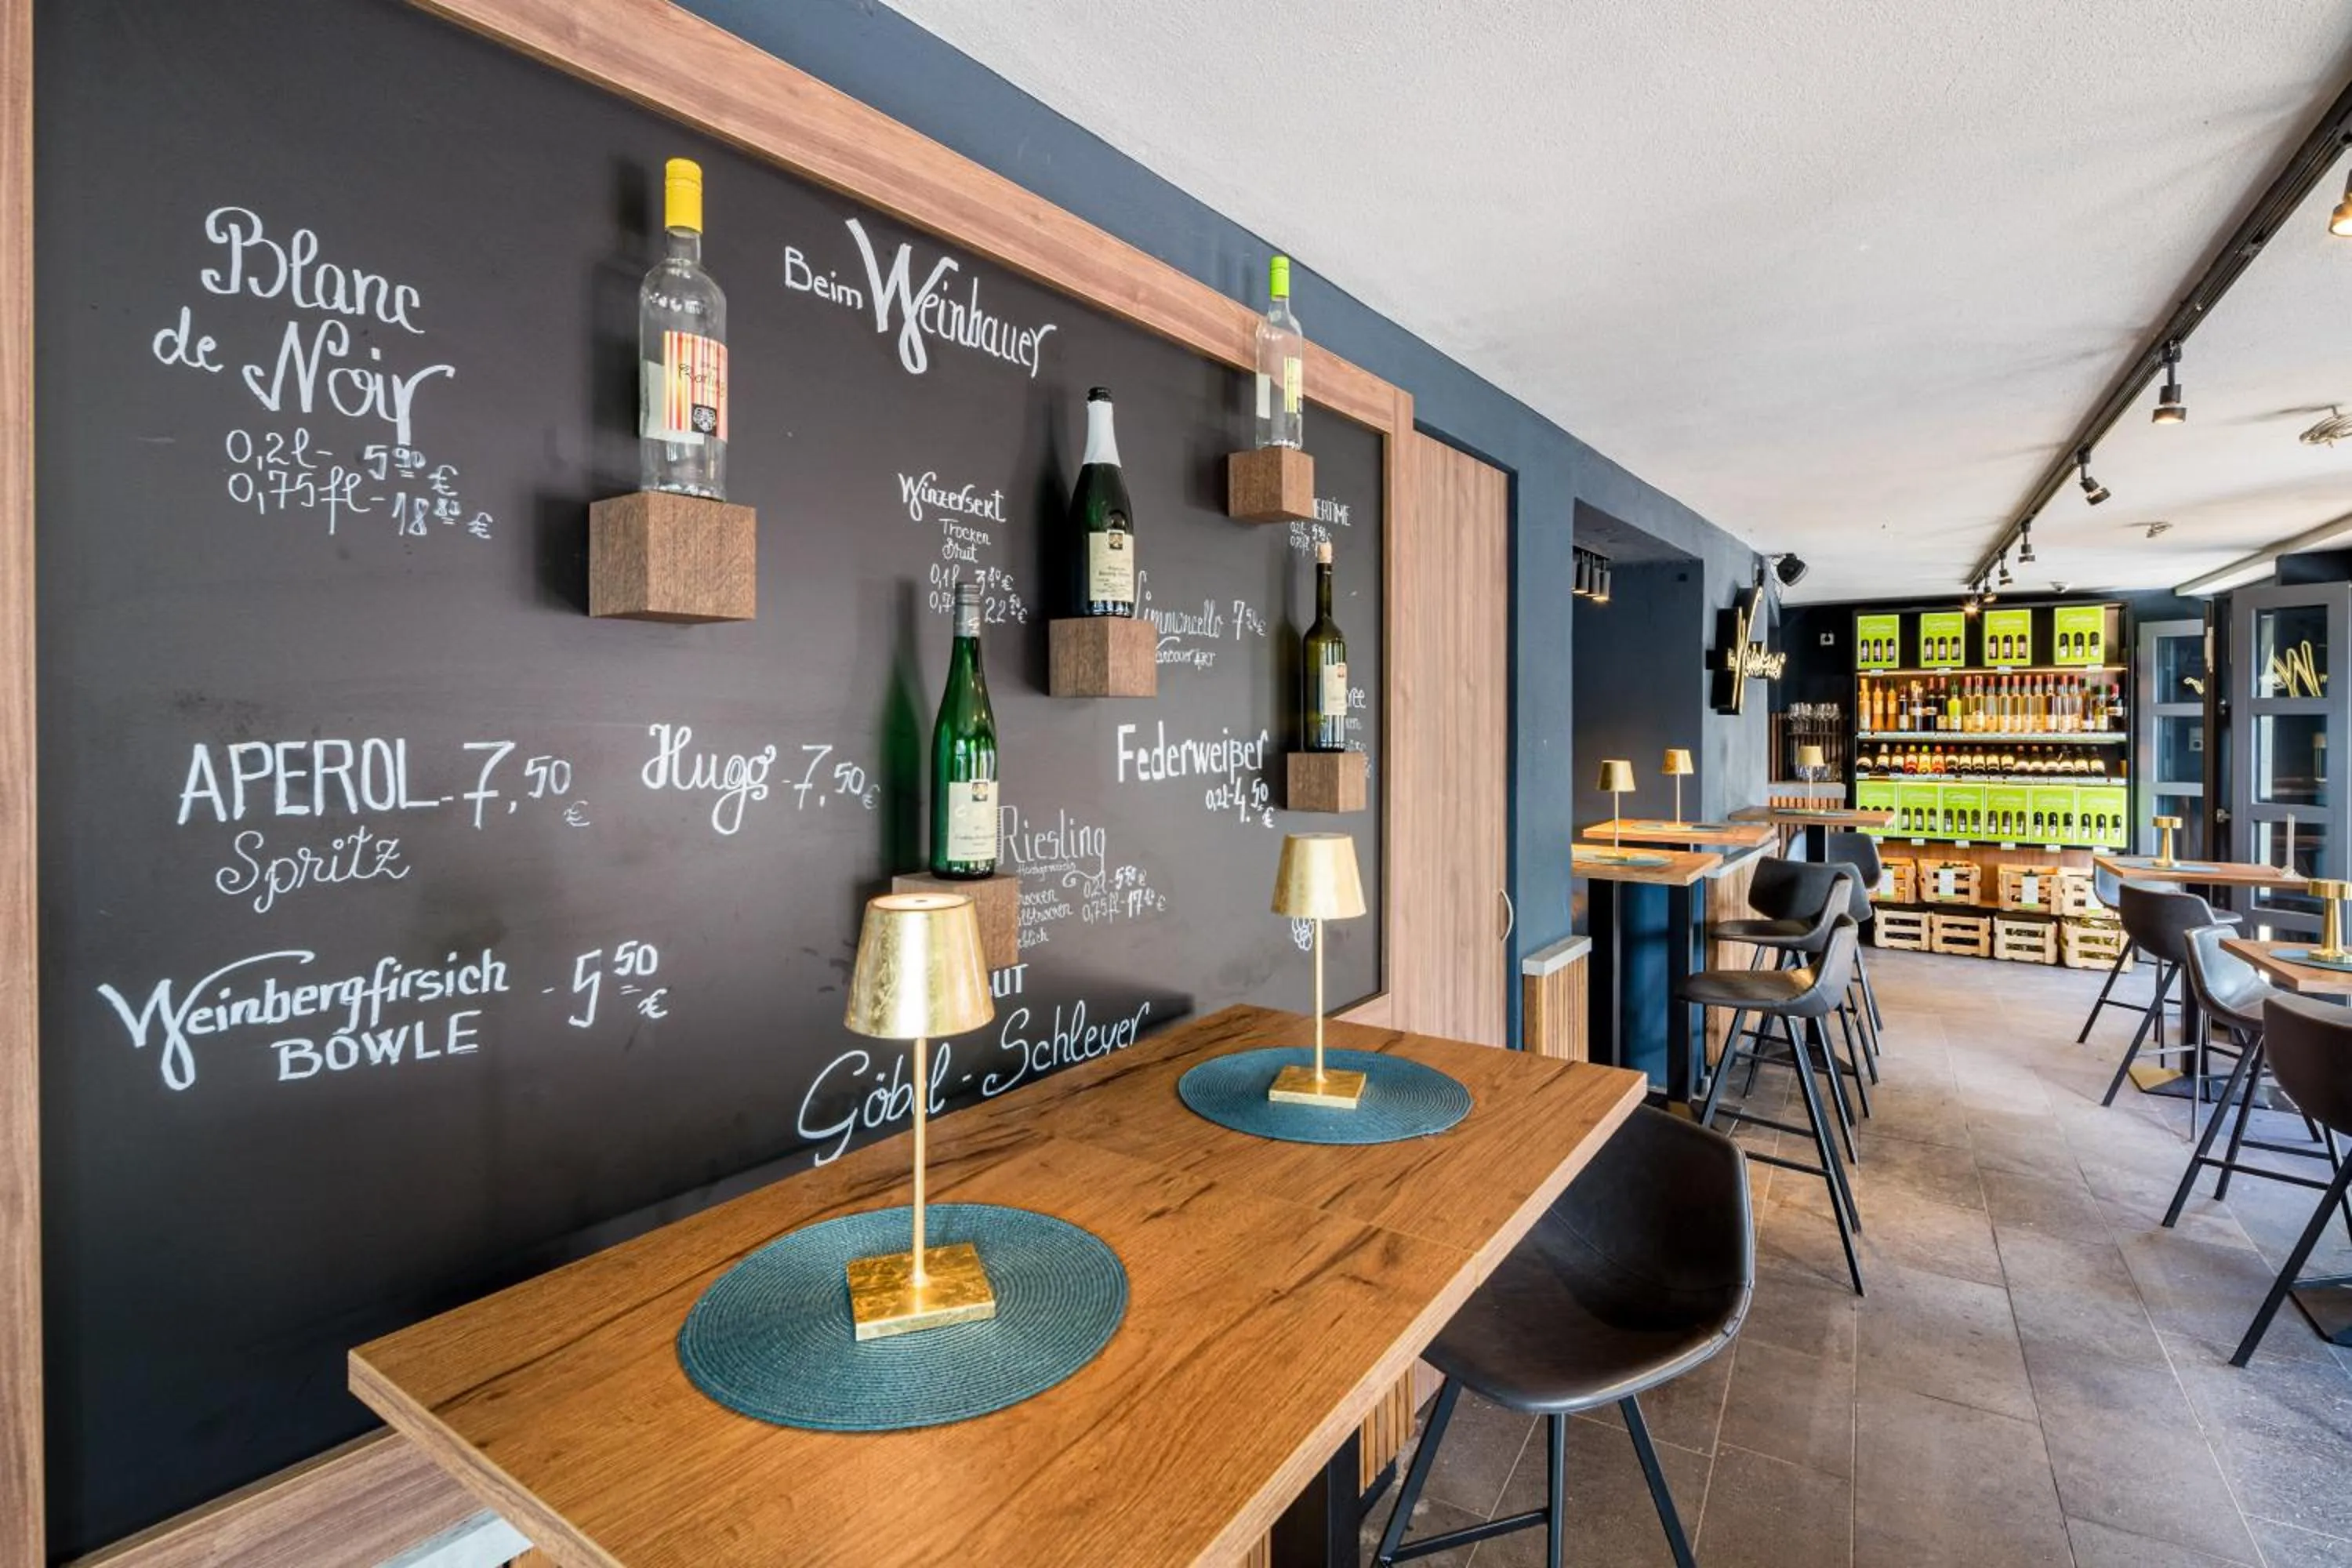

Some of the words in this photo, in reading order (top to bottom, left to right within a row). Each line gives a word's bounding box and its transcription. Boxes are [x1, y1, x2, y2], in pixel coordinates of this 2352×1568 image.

[201, 206, 425, 333] Blanc
[785, 246, 862, 309] Beim
[844, 218, 1057, 378] Weinbauer
[153, 306, 224, 372] de
[242, 319, 455, 445] Noir
[898, 471, 1007, 522] Winzersekt
[938, 518, 991, 546] Trocken
[178, 737, 440, 825] APEROL
[641, 723, 777, 835] Hugo
[216, 825, 410, 913] Spritz
[996, 805, 1106, 888] Riesling
[270, 1011, 481, 1081] BOWLE
[797, 1043, 950, 1167] Göbl
